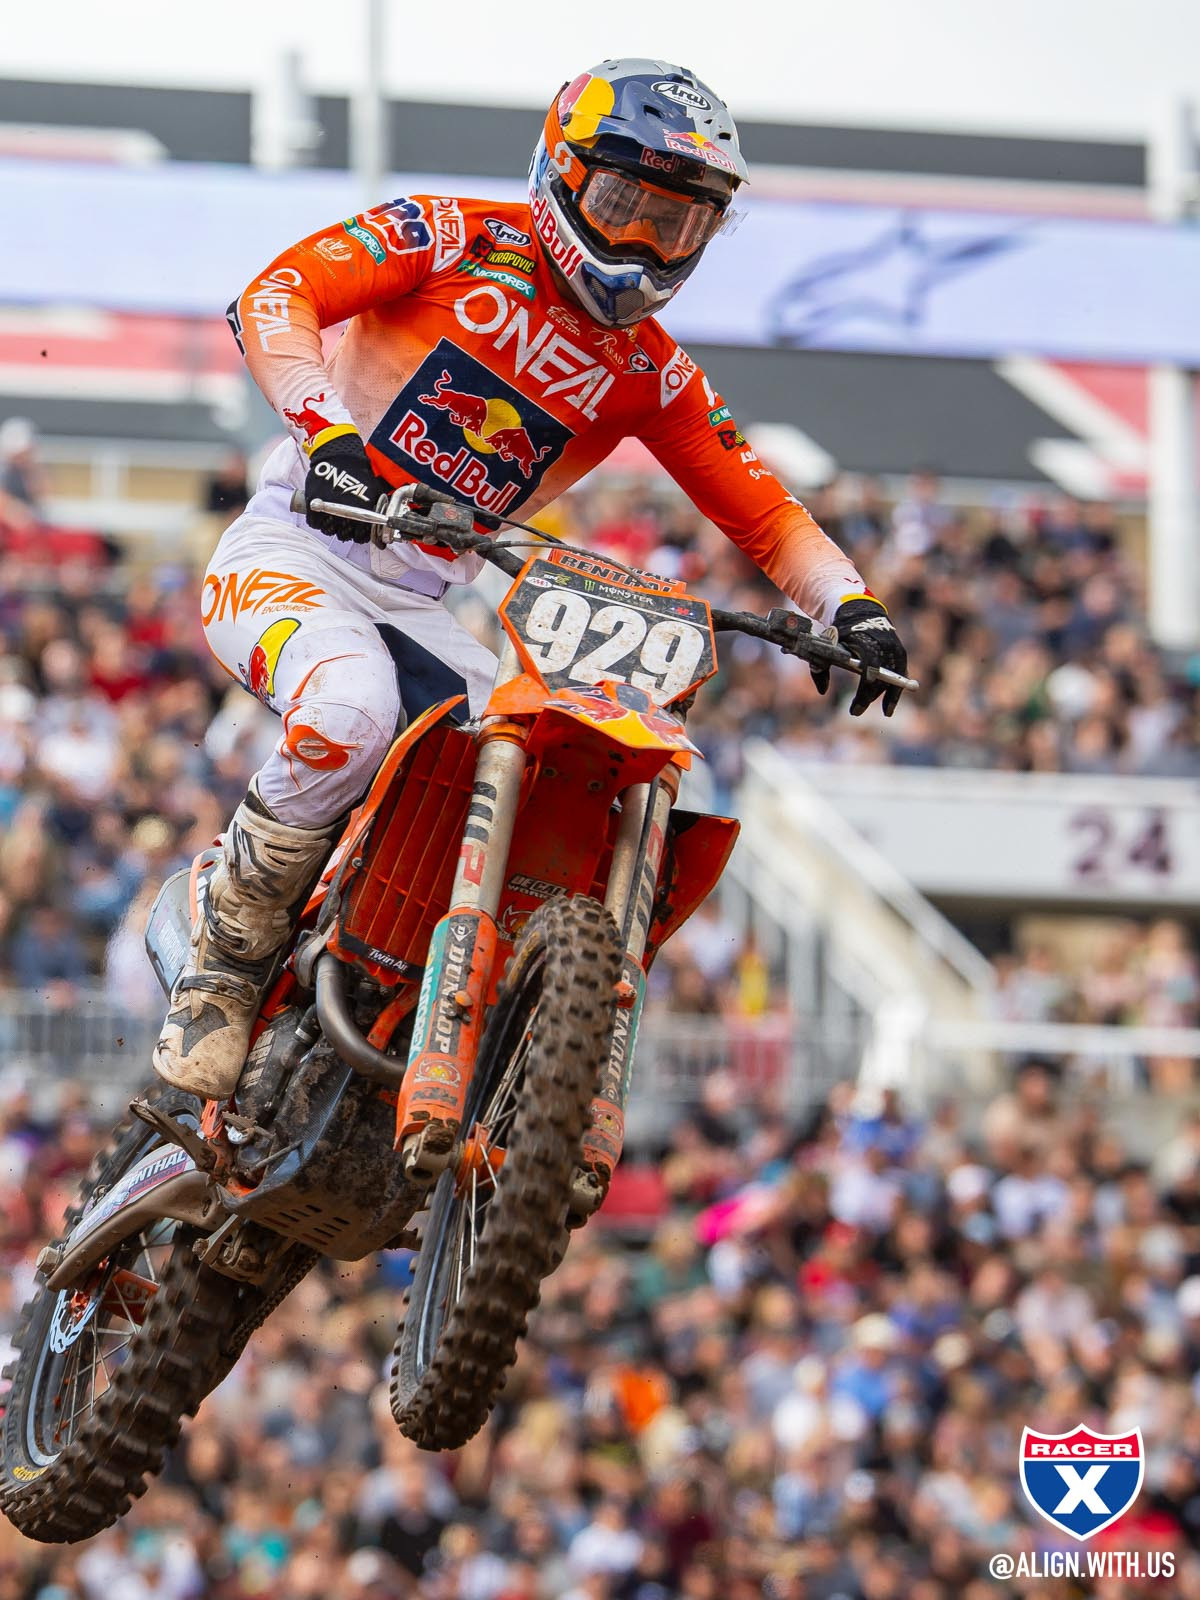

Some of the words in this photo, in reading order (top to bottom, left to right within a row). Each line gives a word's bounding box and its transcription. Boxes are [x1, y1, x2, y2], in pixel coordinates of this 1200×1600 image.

[349, 226, 383, 259] MOTOREX
[472, 266, 534, 297] MOTOREX
[525, 589, 706, 708] 929
[1069, 805, 1171, 884] 24
[608, 968, 634, 1082] DUNLP
